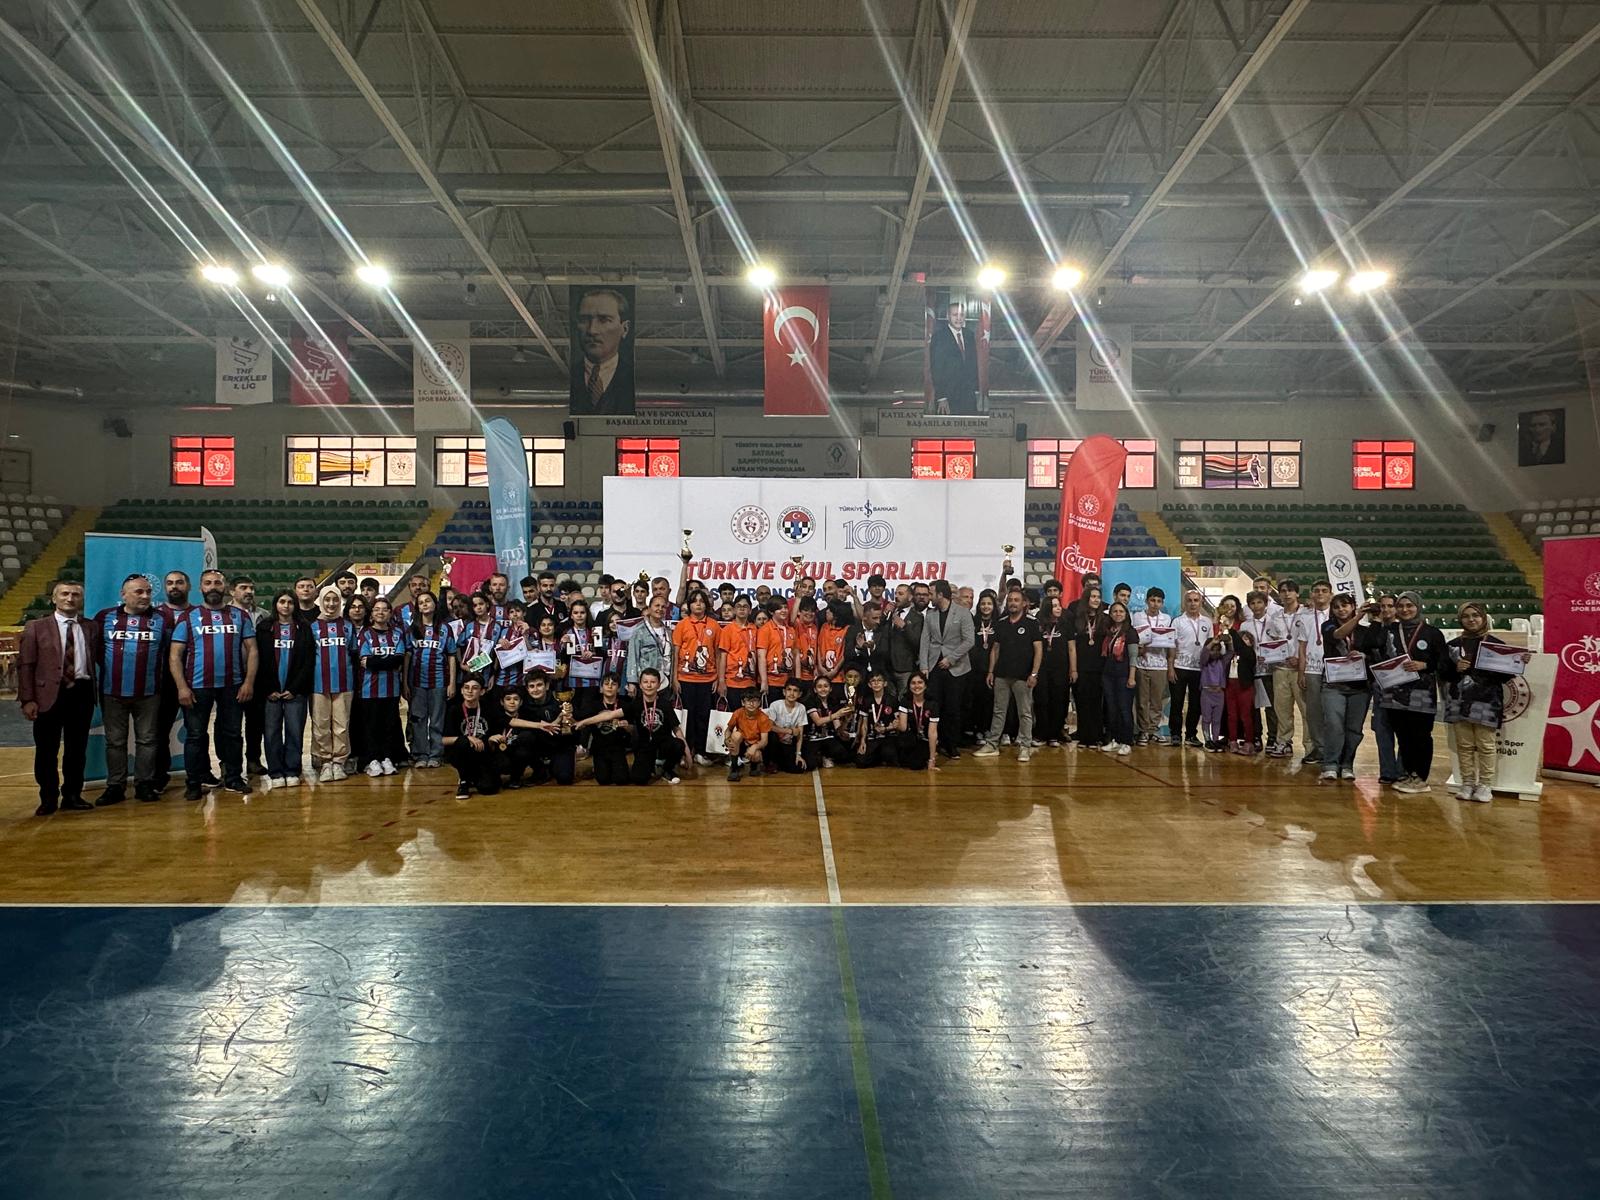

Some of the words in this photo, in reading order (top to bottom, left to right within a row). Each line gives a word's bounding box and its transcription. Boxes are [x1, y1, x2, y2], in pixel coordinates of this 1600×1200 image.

[842, 519, 895, 550] 100
[687, 558, 776, 580] TÜRKİYE
[780, 561, 837, 581] OKUL
[841, 561, 948, 581] SPORLARI
[194, 624, 240, 635] VESTEL
[108, 630, 157, 641] VESTEL
[274, 639, 295, 649] EST
[1504, 739, 1525, 748] Spor
